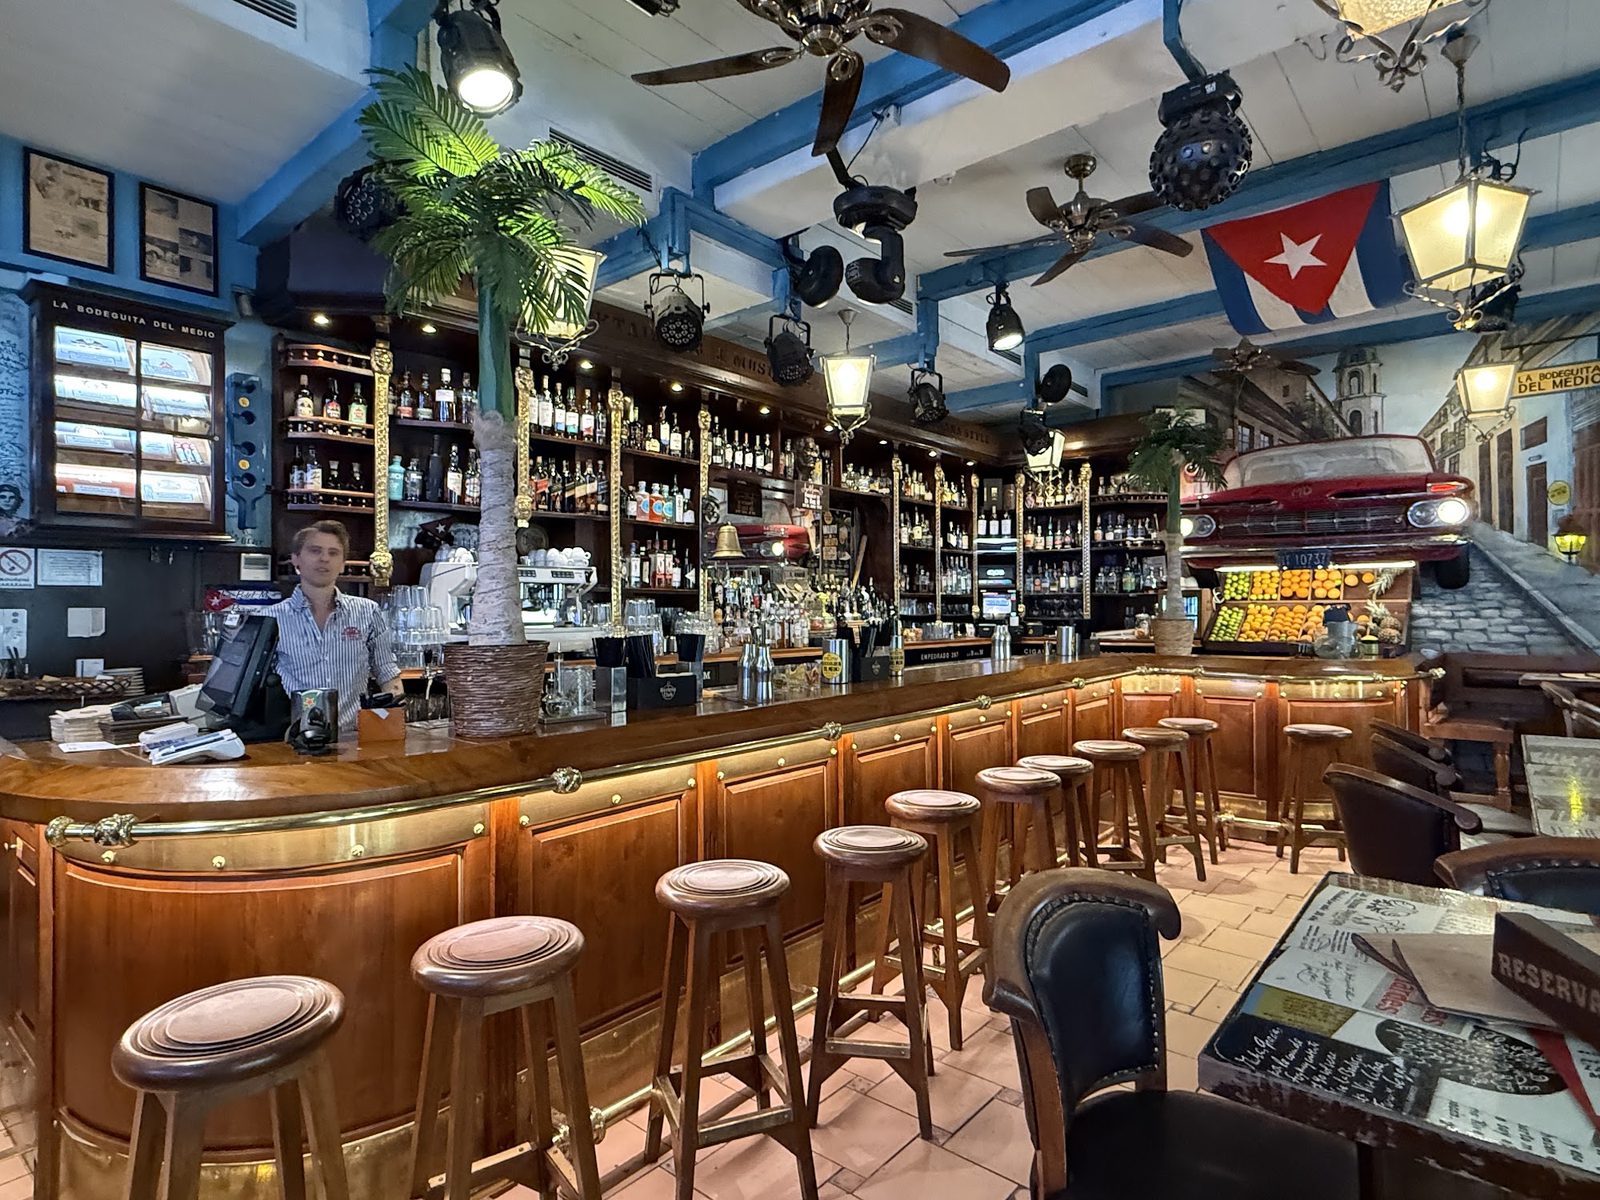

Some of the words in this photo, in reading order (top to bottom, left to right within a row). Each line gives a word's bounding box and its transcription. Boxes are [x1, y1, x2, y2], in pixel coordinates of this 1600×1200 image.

[53, 300, 69, 310] LA
[76, 304, 147, 326] BODEGUITA
[153, 320, 175, 331] DEL
[181, 325, 216, 339] MEDIO
[1517, 374, 1533, 384] LA
[1538, 364, 1600, 381] BODEGUITA
[1518, 381, 1546, 394] DEL
[1294, 552, 1326, 566] 10737
